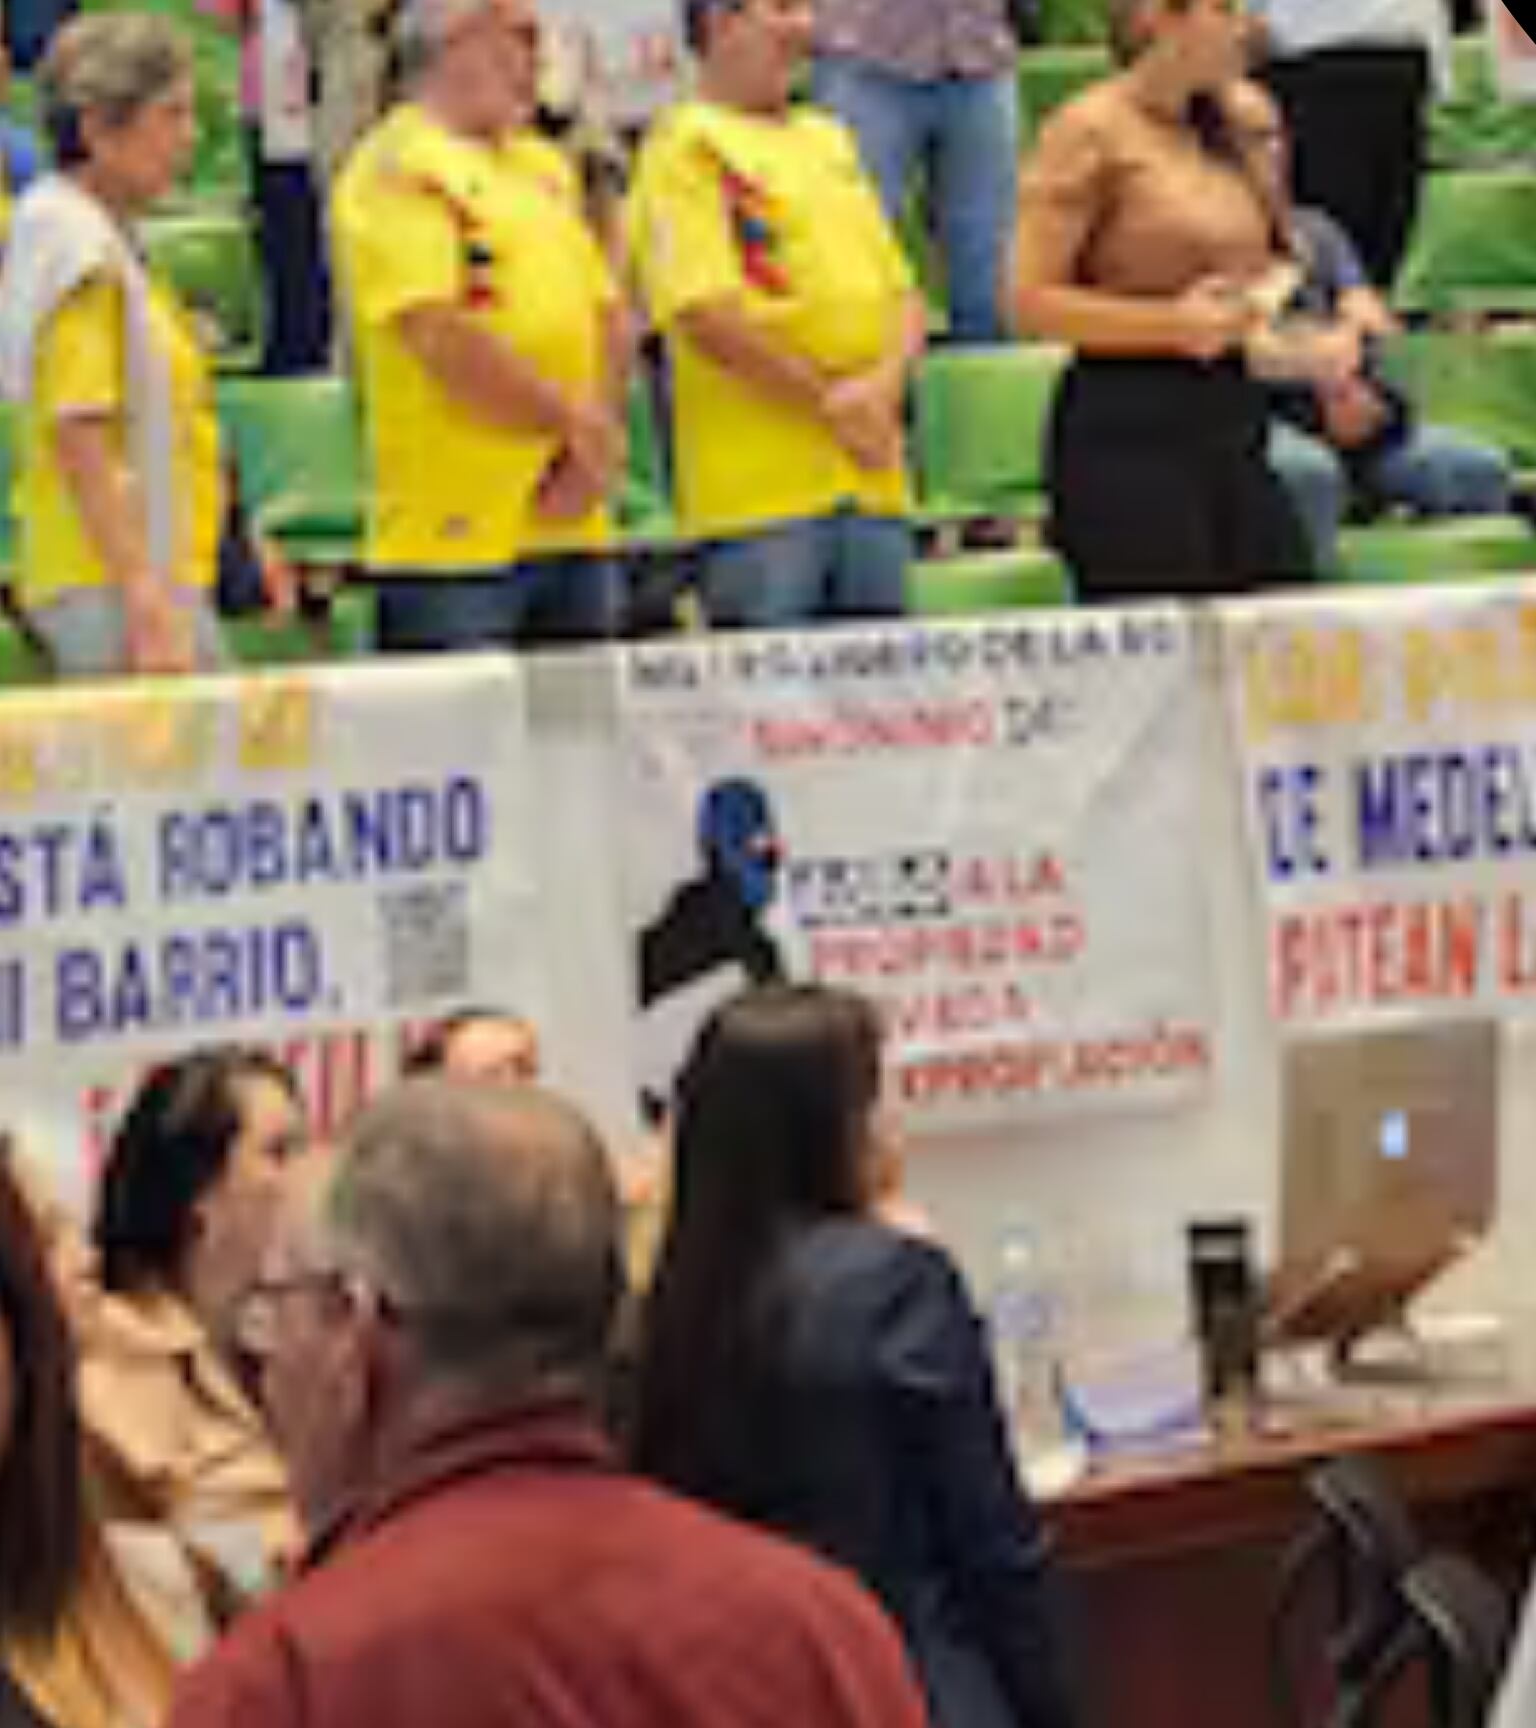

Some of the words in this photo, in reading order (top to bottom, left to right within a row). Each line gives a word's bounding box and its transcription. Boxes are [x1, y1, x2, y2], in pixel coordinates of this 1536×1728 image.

[982, 628, 1037, 668] DE
[1052, 622, 1107, 664] LA
[158, 772, 484, 898] ROBANDO
[54, 920, 342, 1042] BARRIO.
